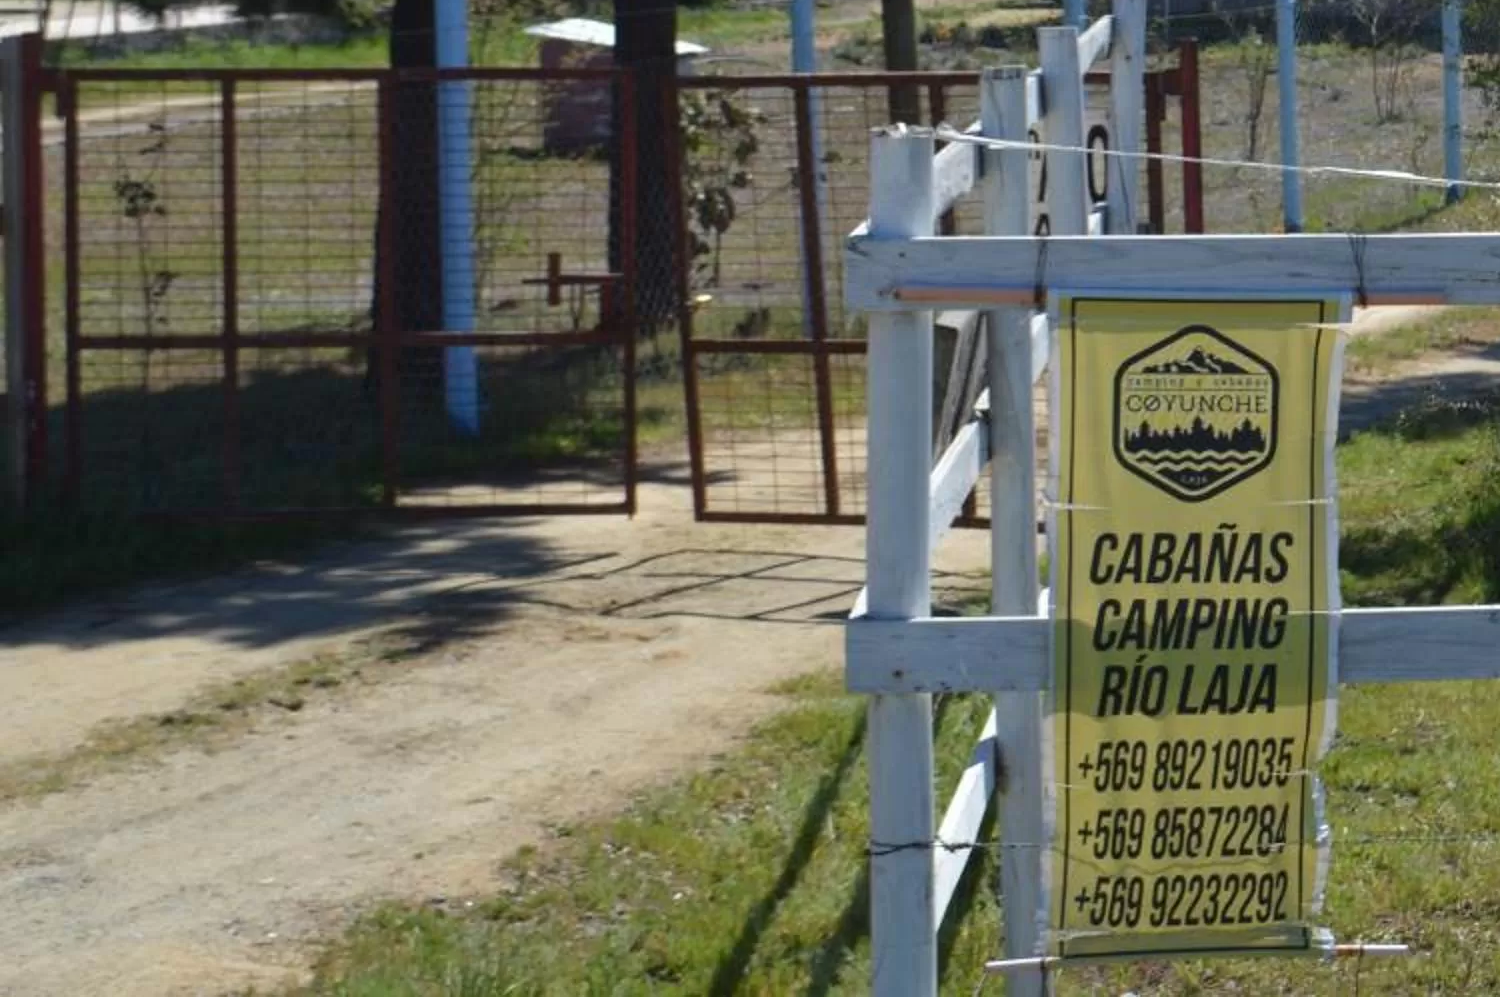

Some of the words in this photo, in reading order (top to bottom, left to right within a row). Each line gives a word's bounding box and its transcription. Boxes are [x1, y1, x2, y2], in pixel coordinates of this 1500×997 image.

[1089, 523, 1294, 585] CABAÑAS
[1092, 598, 1289, 651] CAMPING
[1096, 654, 1170, 717] RÍO
[1176, 664, 1278, 715] LAJA
[1078, 740, 1147, 792] +569
[1152, 737, 1295, 791] 89219035
[1078, 808, 1146, 859] +569
[1151, 802, 1290, 859] 85872284
[1074, 876, 1144, 927] +569
[1150, 870, 1289, 927] 92232292
